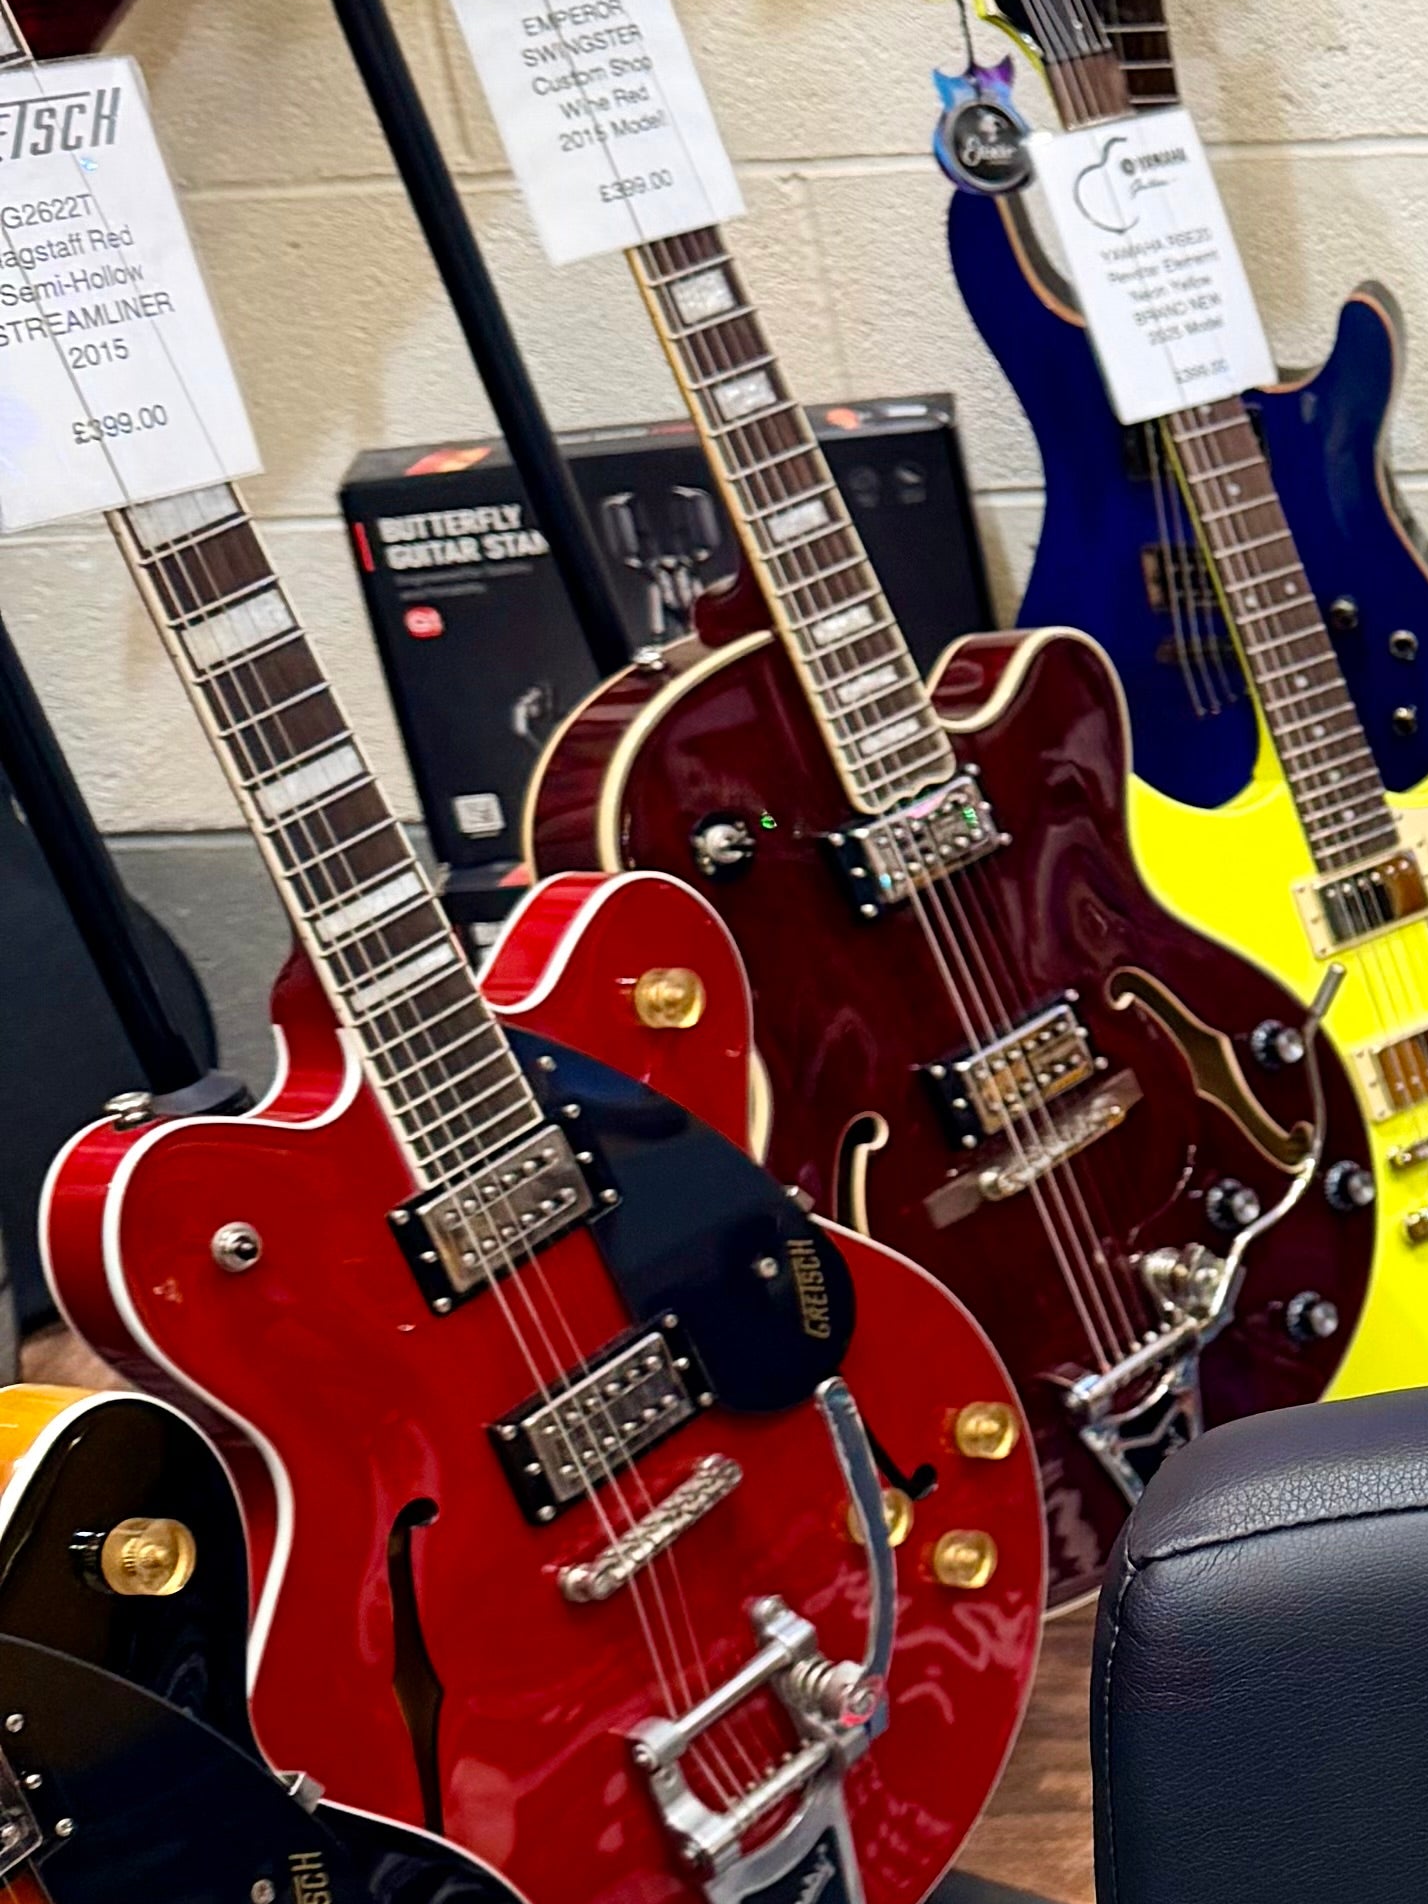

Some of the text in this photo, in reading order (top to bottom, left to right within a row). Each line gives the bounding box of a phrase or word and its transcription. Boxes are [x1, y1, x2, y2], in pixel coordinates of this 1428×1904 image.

[521, 24, 643, 68] SWINGSTER
[531, 54, 654, 97] Custom Shop
[559, 86, 650, 121] Wine Red
[610, 111, 667, 138] Model
[1, 193, 94, 231] G2622T
[0, 224, 135, 272] agstaff Red
[1, 260, 146, 307] Semi-Hollow
[0, 291, 175, 348] STREAMLINER
[70, 338, 130, 371] 2015
[73, 404, 168, 445] £399.00
[379, 503, 522, 543] BUTTERFLY
[385, 536, 483, 570] GUITAR
